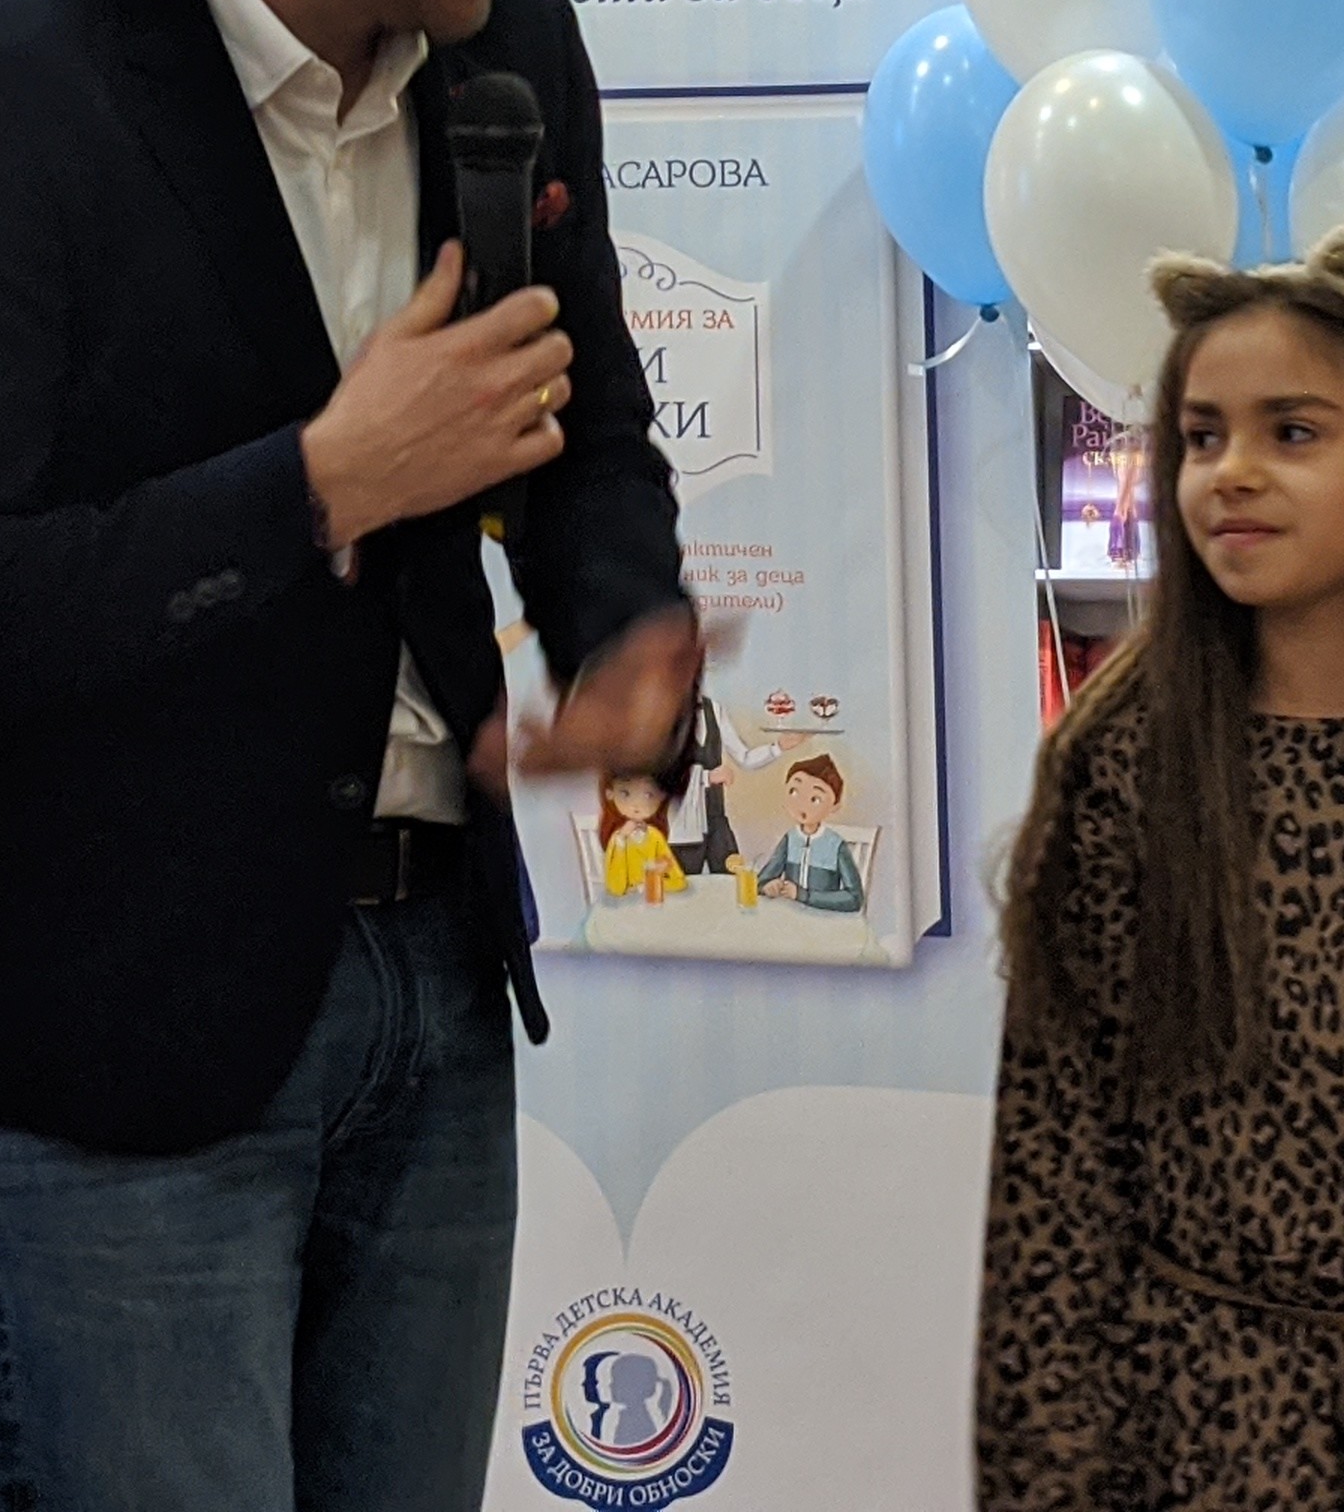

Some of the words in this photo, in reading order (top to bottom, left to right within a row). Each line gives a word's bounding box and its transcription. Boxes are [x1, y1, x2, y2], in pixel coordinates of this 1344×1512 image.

[625, 309, 693, 330] МИЯ
[702, 309, 735, 330] ЗА
[727, 569, 748, 587] за
[756, 568, 805, 587] деца
[524, 1332, 560, 1410] ПЪРВА
[556, 1287, 643, 1337] ДЕТСКА
[648, 1292, 731, 1407] АКАДЕМИЯ
[532, 1431, 555, 1464] ЗА
[547, 1460, 624, 1506] ДОБРИ
[629, 1426, 725, 1506] ОБНОСКИ
